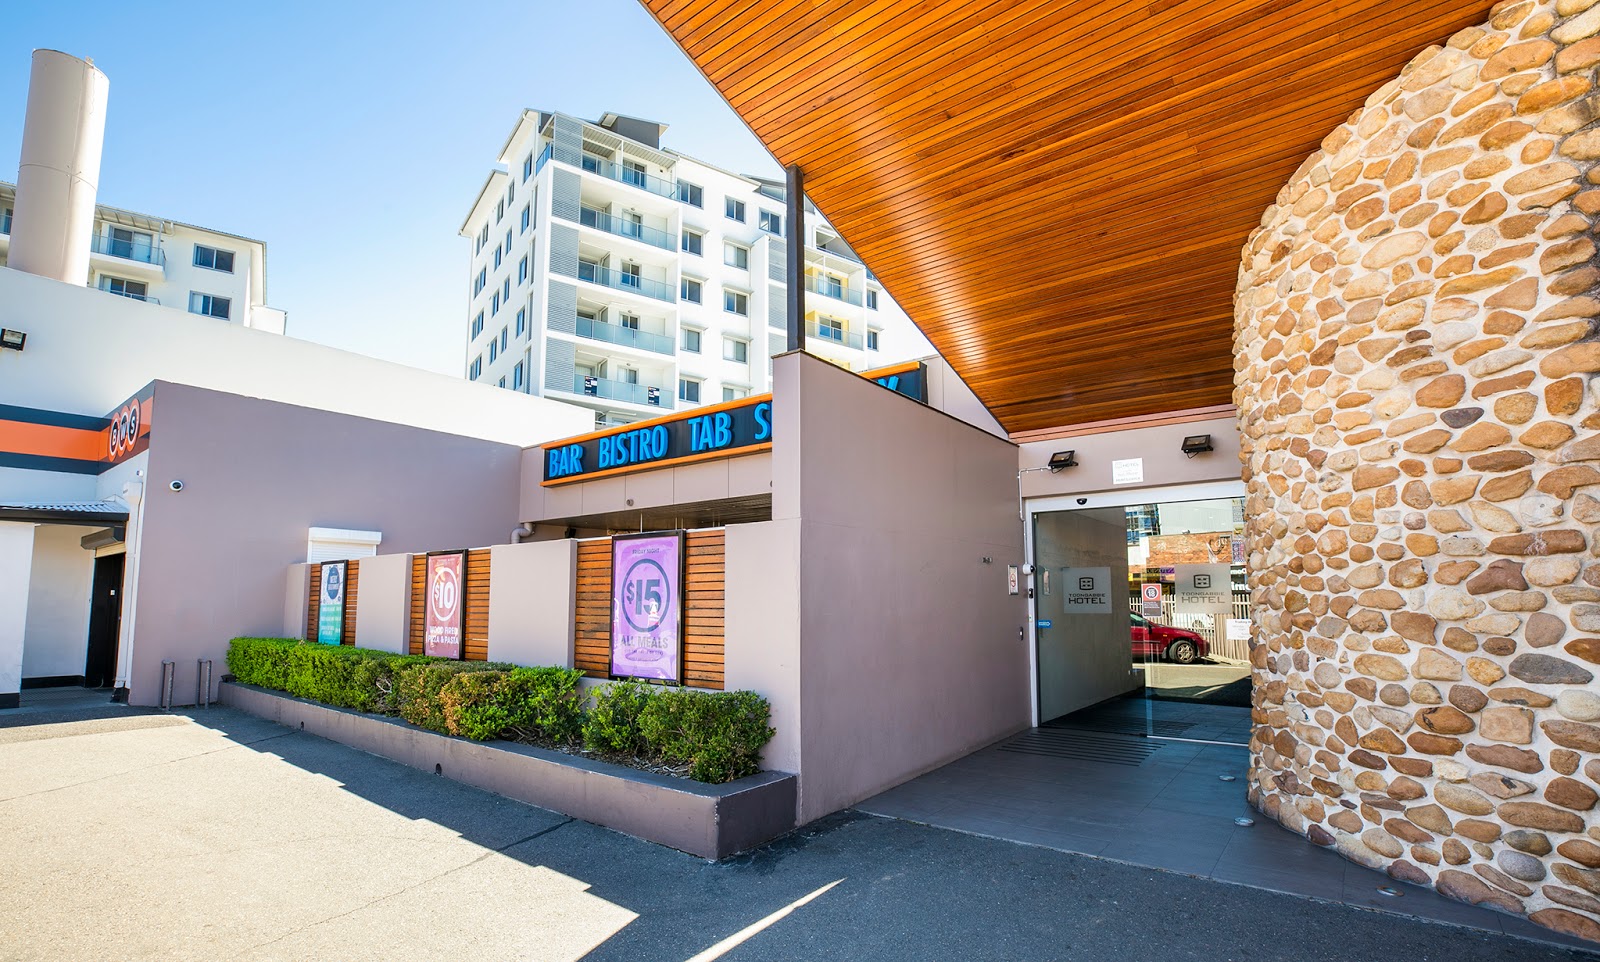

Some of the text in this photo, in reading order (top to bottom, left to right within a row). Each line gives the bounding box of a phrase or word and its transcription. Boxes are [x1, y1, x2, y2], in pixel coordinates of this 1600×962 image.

[549, 402, 772, 478] BAR BISTRO TAB S
[434, 582, 454, 609] $10
[626, 579, 662, 615] $15
[621, 635, 669, 649] ALL MEALS
